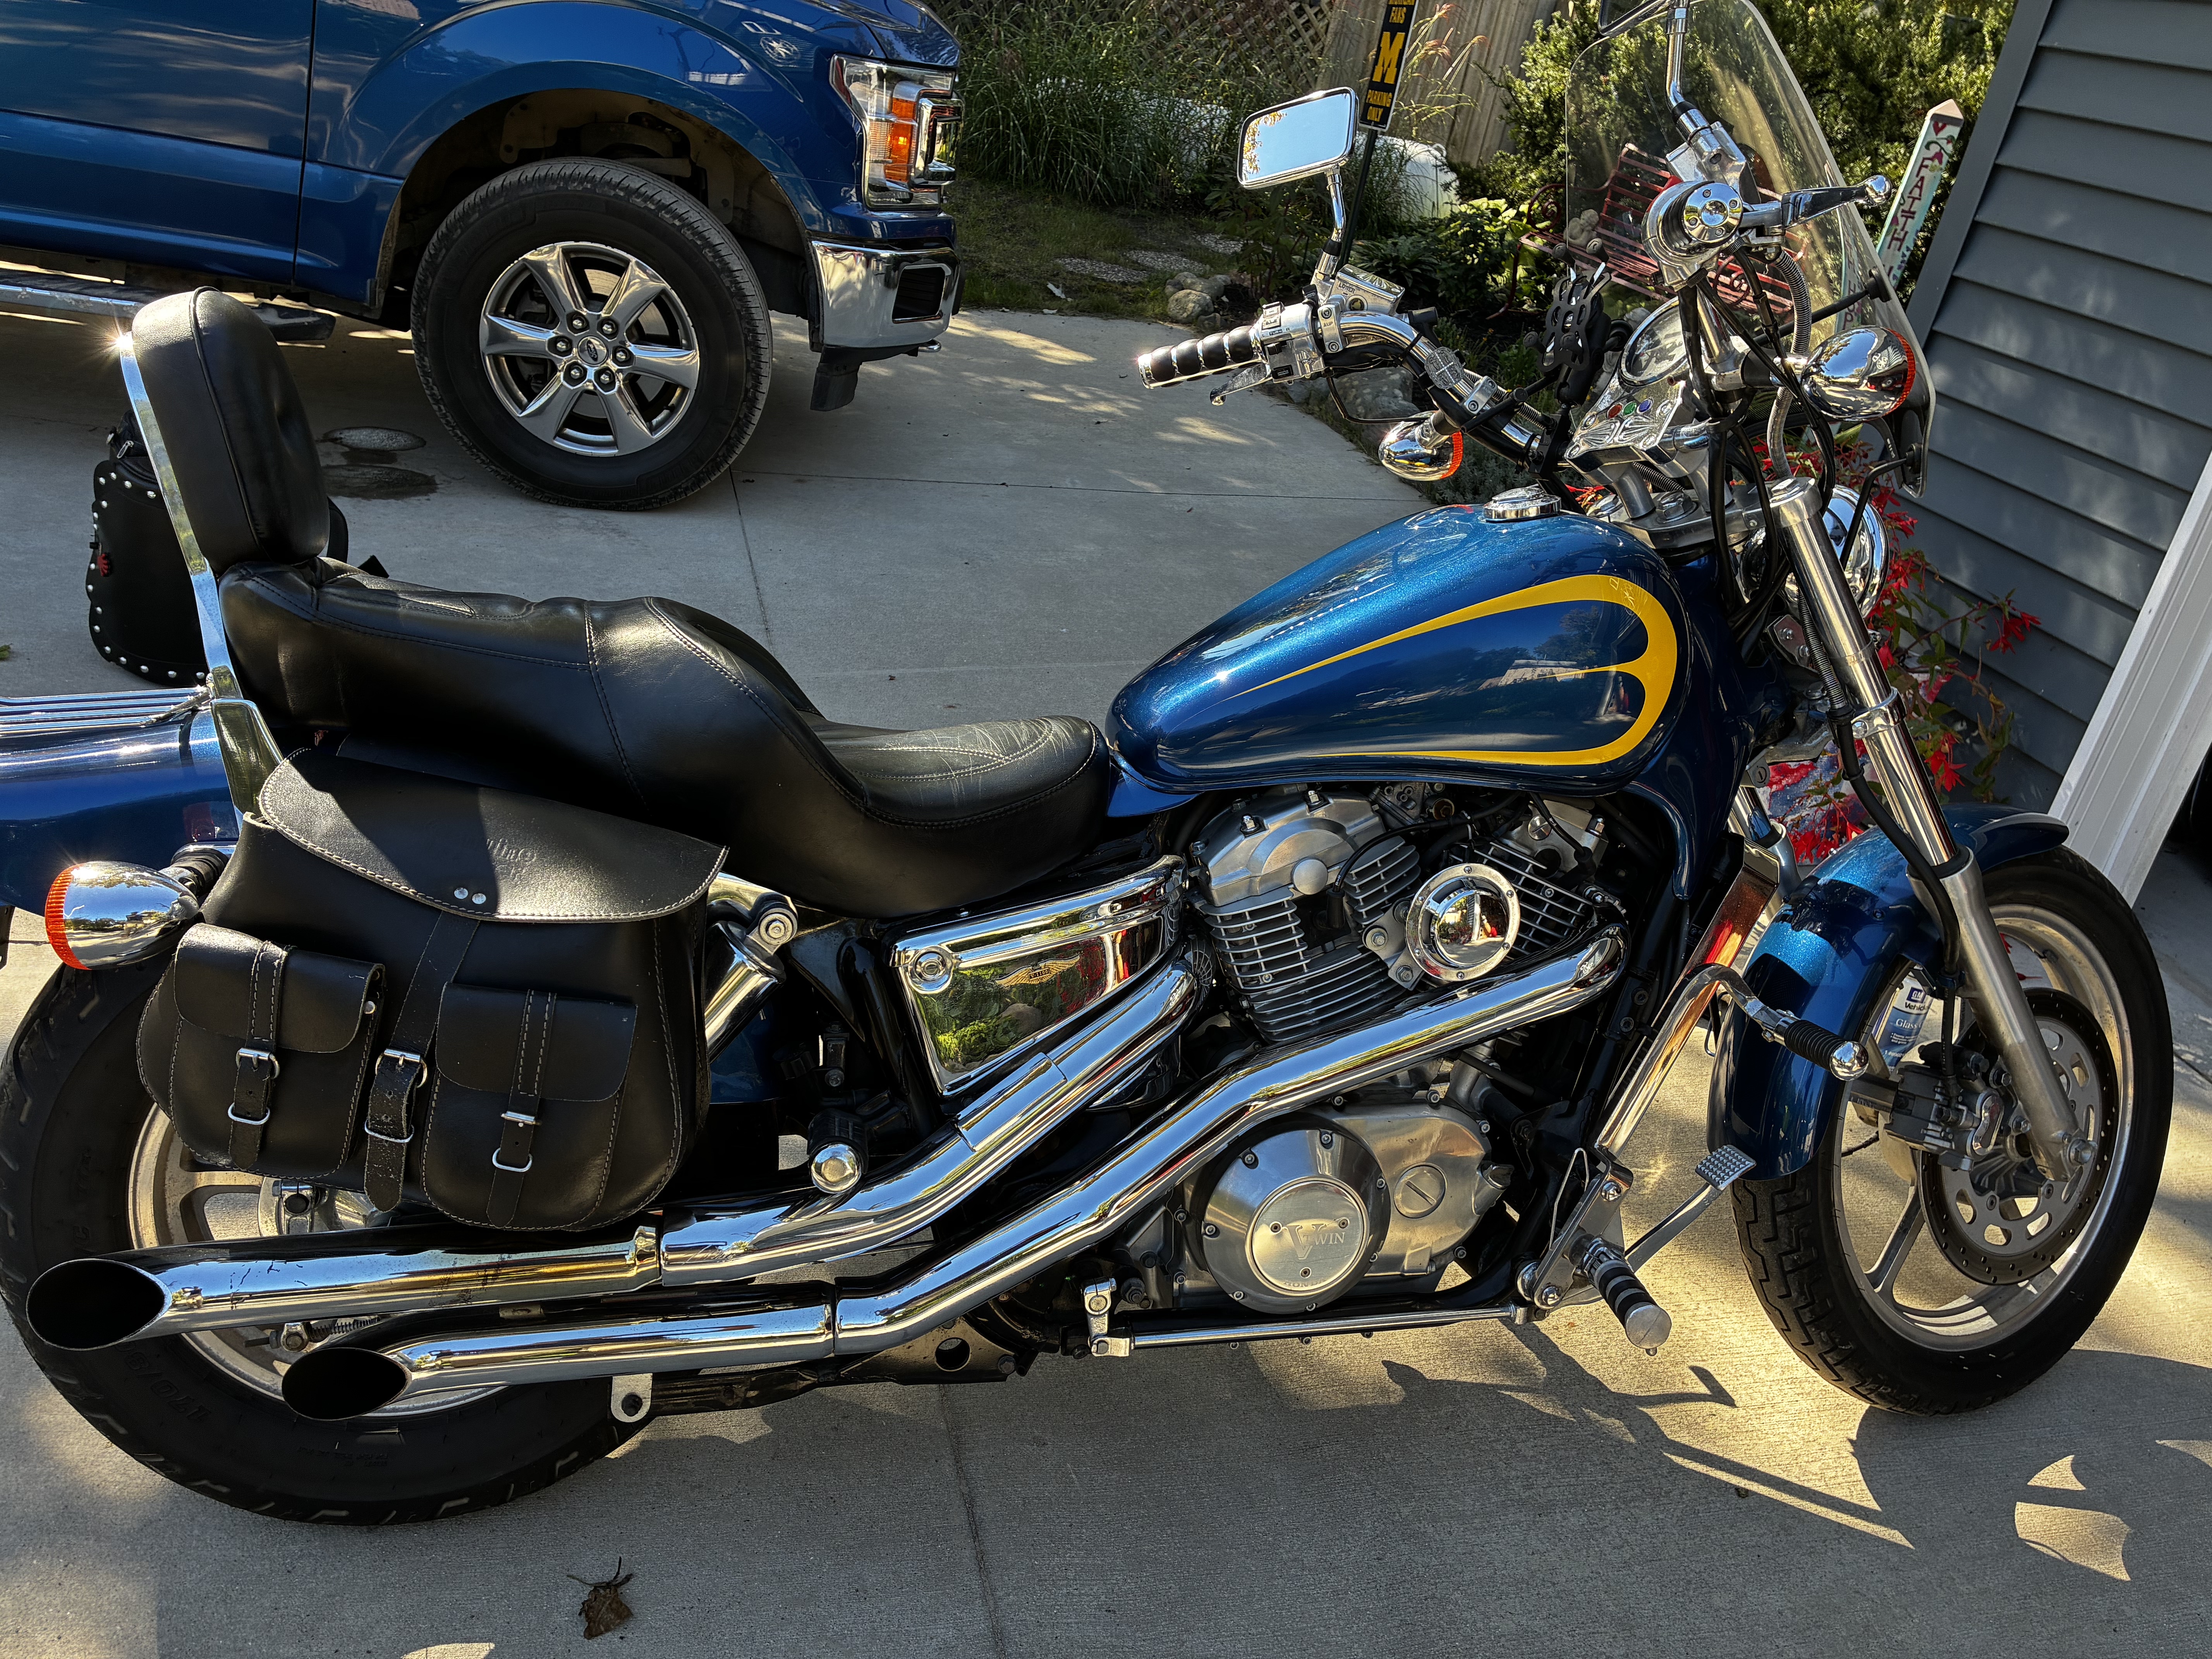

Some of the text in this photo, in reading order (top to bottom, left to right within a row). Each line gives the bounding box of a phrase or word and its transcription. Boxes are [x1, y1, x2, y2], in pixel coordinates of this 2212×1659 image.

[1389, 7, 1407, 24] FANS
[1372, 31, 1406, 84] M
[1366, 89, 1392, 107] PARKING
[1367, 106, 1383, 122] ONLY
[1887, 156, 1933, 251] FAITH
[587, 343, 597, 358] Ford
[1912, 990, 1924, 999] GM
[1896, 1018, 1916, 1029] Glass
[1283, 1278, 1327, 1288] HONDA
